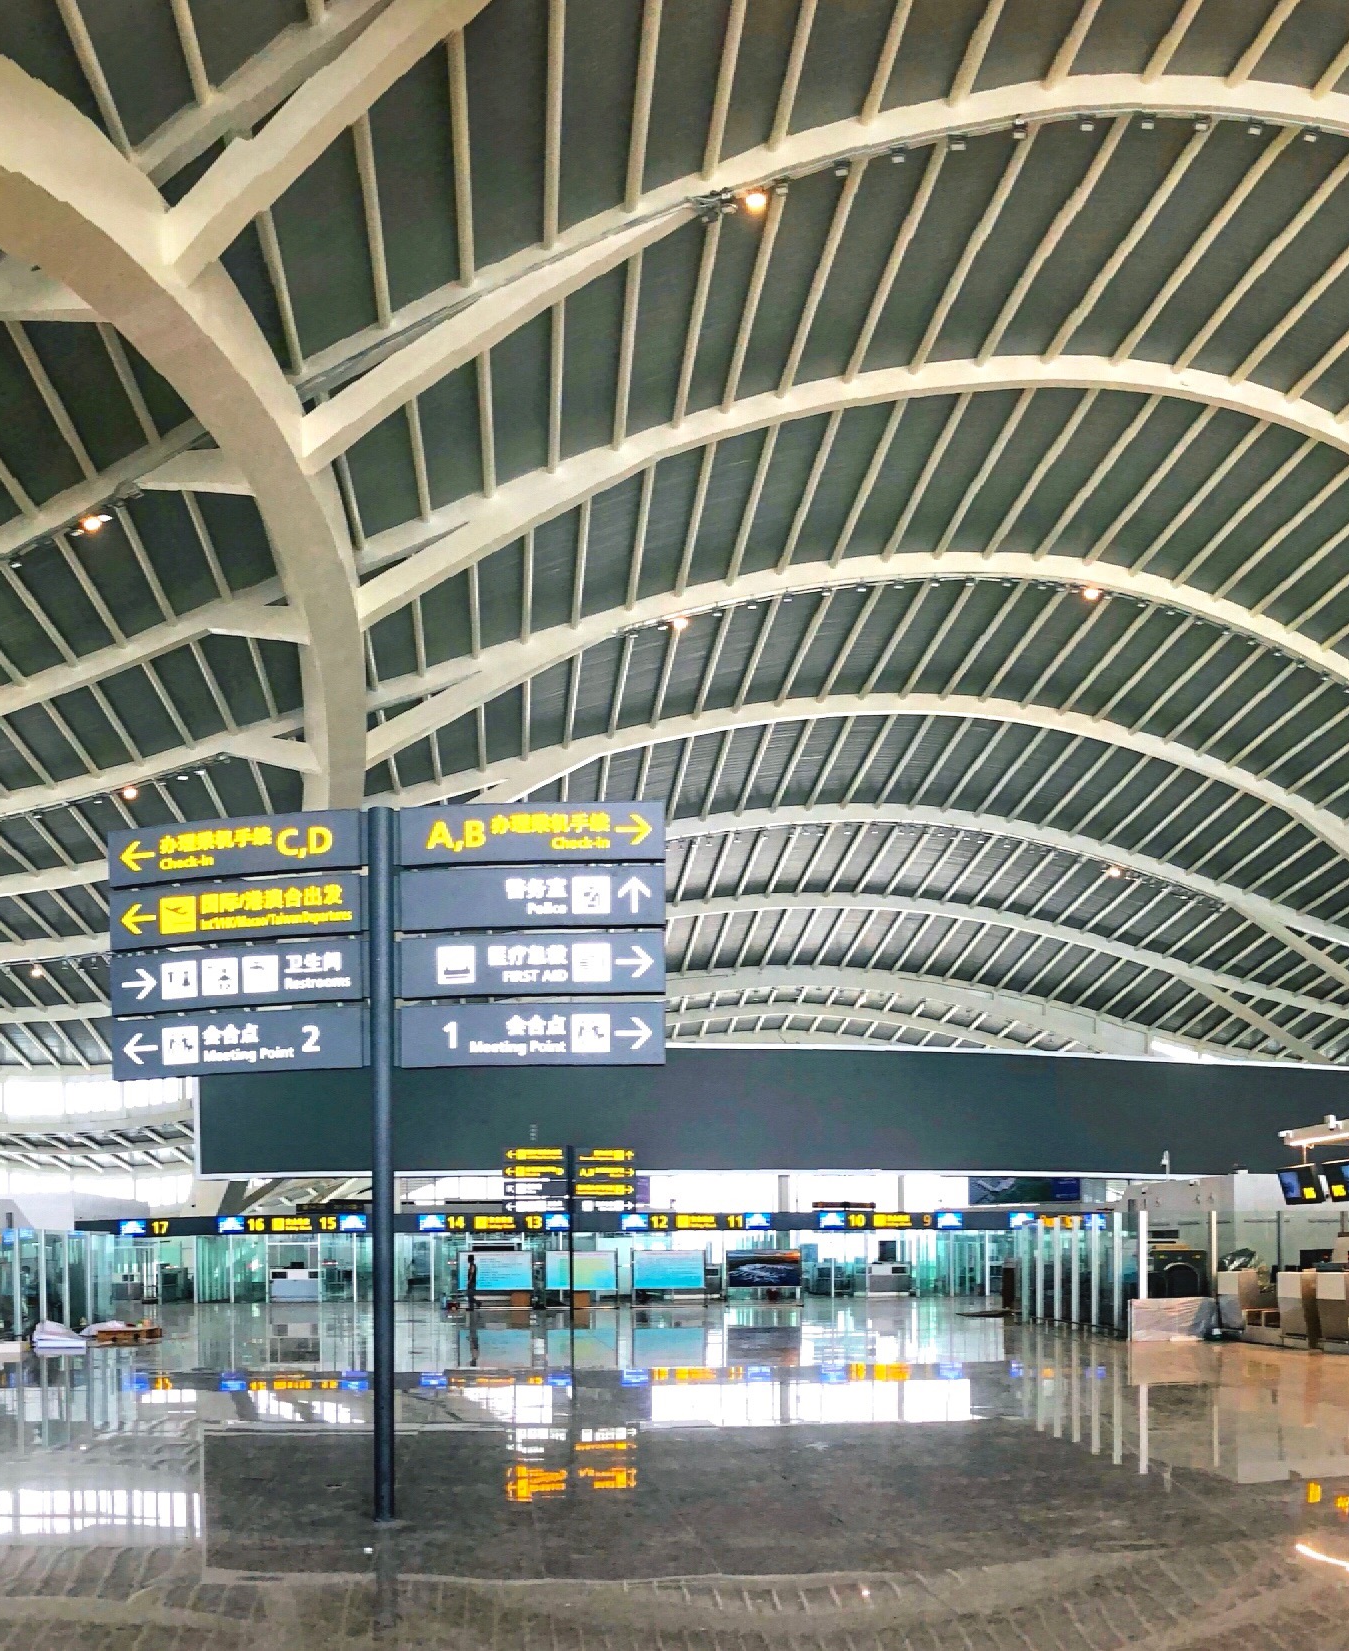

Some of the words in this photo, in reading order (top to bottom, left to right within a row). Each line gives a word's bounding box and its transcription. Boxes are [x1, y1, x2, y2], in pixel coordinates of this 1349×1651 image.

[276, 826, 334, 858] C,D
[426, 820, 487, 852] A,B
[526, 901, 568, 915] Police
[283, 951, 343, 974] 卫生间
[301, 1025, 321, 1053] 2
[441, 1021, 458, 1049] 1
[202, 1050, 257, 1063] Meeting
[259, 1046, 295, 1060] Point
[469, 1040, 527, 1056] Meeting
[529, 1040, 567, 1053] Point
[151, 1220, 169, 1235] 17
[247, 1218, 265, 1231] 16
[319, 1216, 337, 1230] 15
[447, 1216, 465, 1229] 14
[525, 1215, 543, 1229] 13
[650, 1214, 668, 1228] 12
[727, 1214, 743, 1228] 11
[848, 1213, 864, 1228] 10
